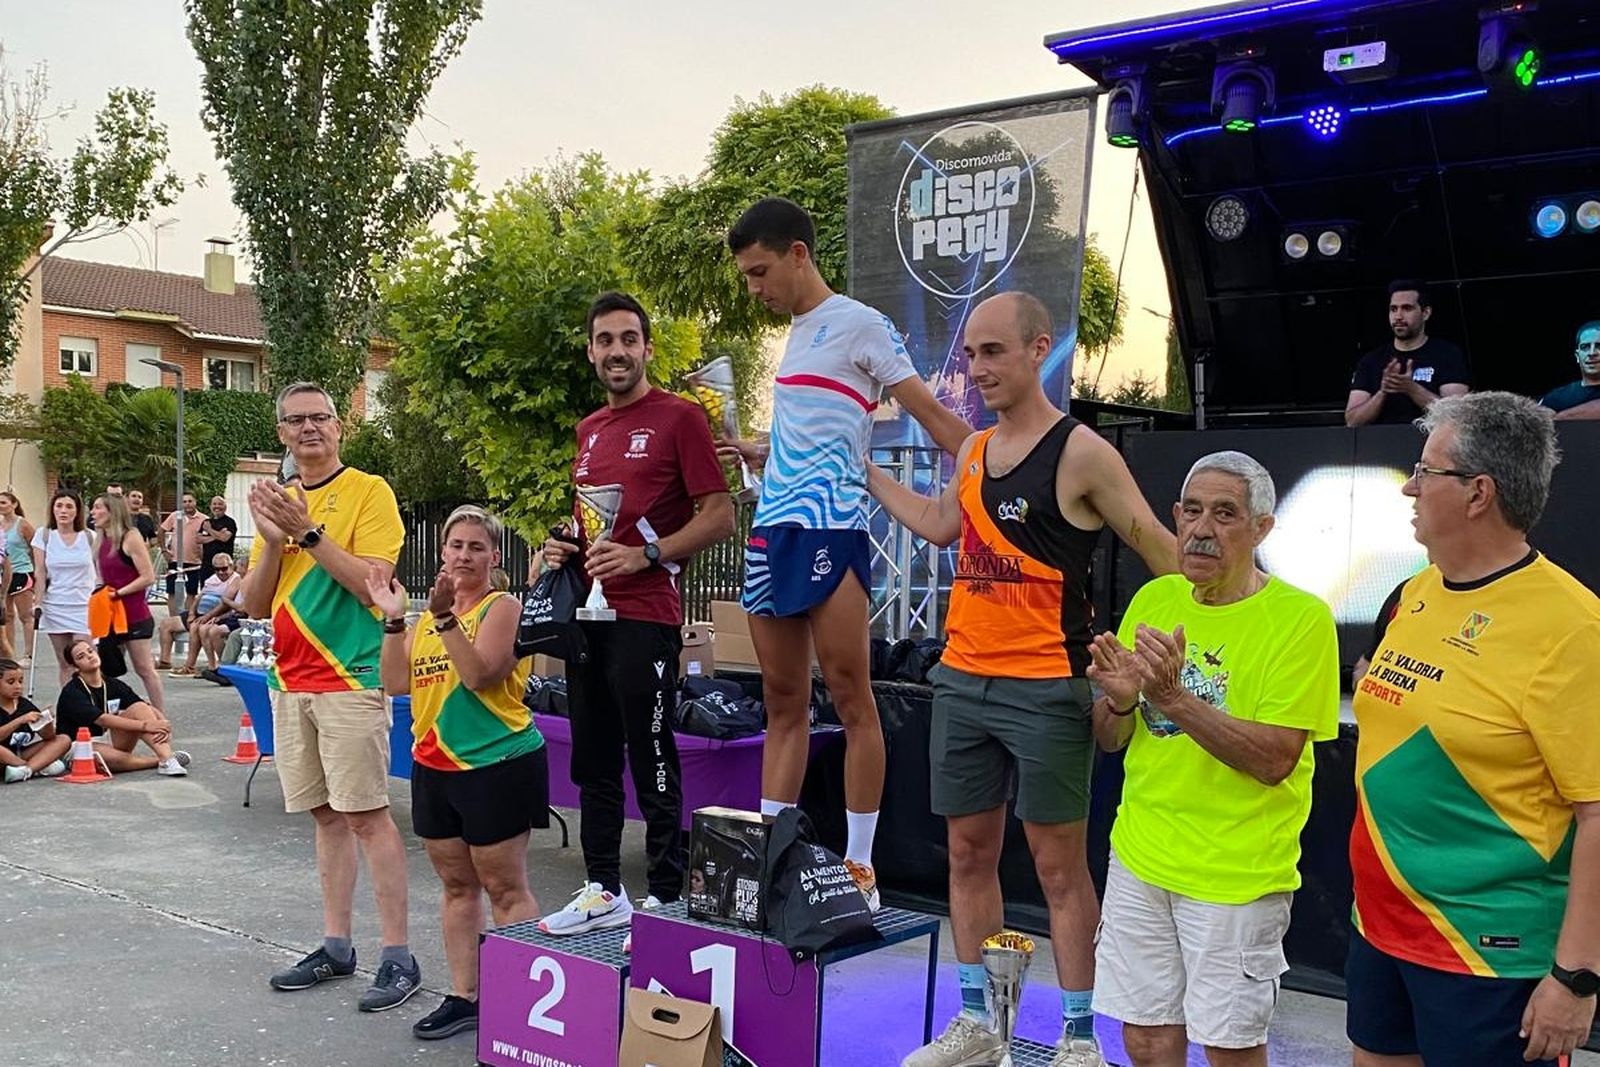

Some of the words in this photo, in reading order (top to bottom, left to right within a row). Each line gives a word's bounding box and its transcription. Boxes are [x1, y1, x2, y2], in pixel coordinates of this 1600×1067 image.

[935, 149, 1012, 172] Discomovida
[1369, 664, 1382, 677] LA
[1379, 668, 1418, 692] BUENA
[1394, 654, 1445, 682] VALORIA
[651, 690, 664, 733] CIUDAD
[656, 762, 666, 792] TORO
[527, 955, 567, 1037] 2
